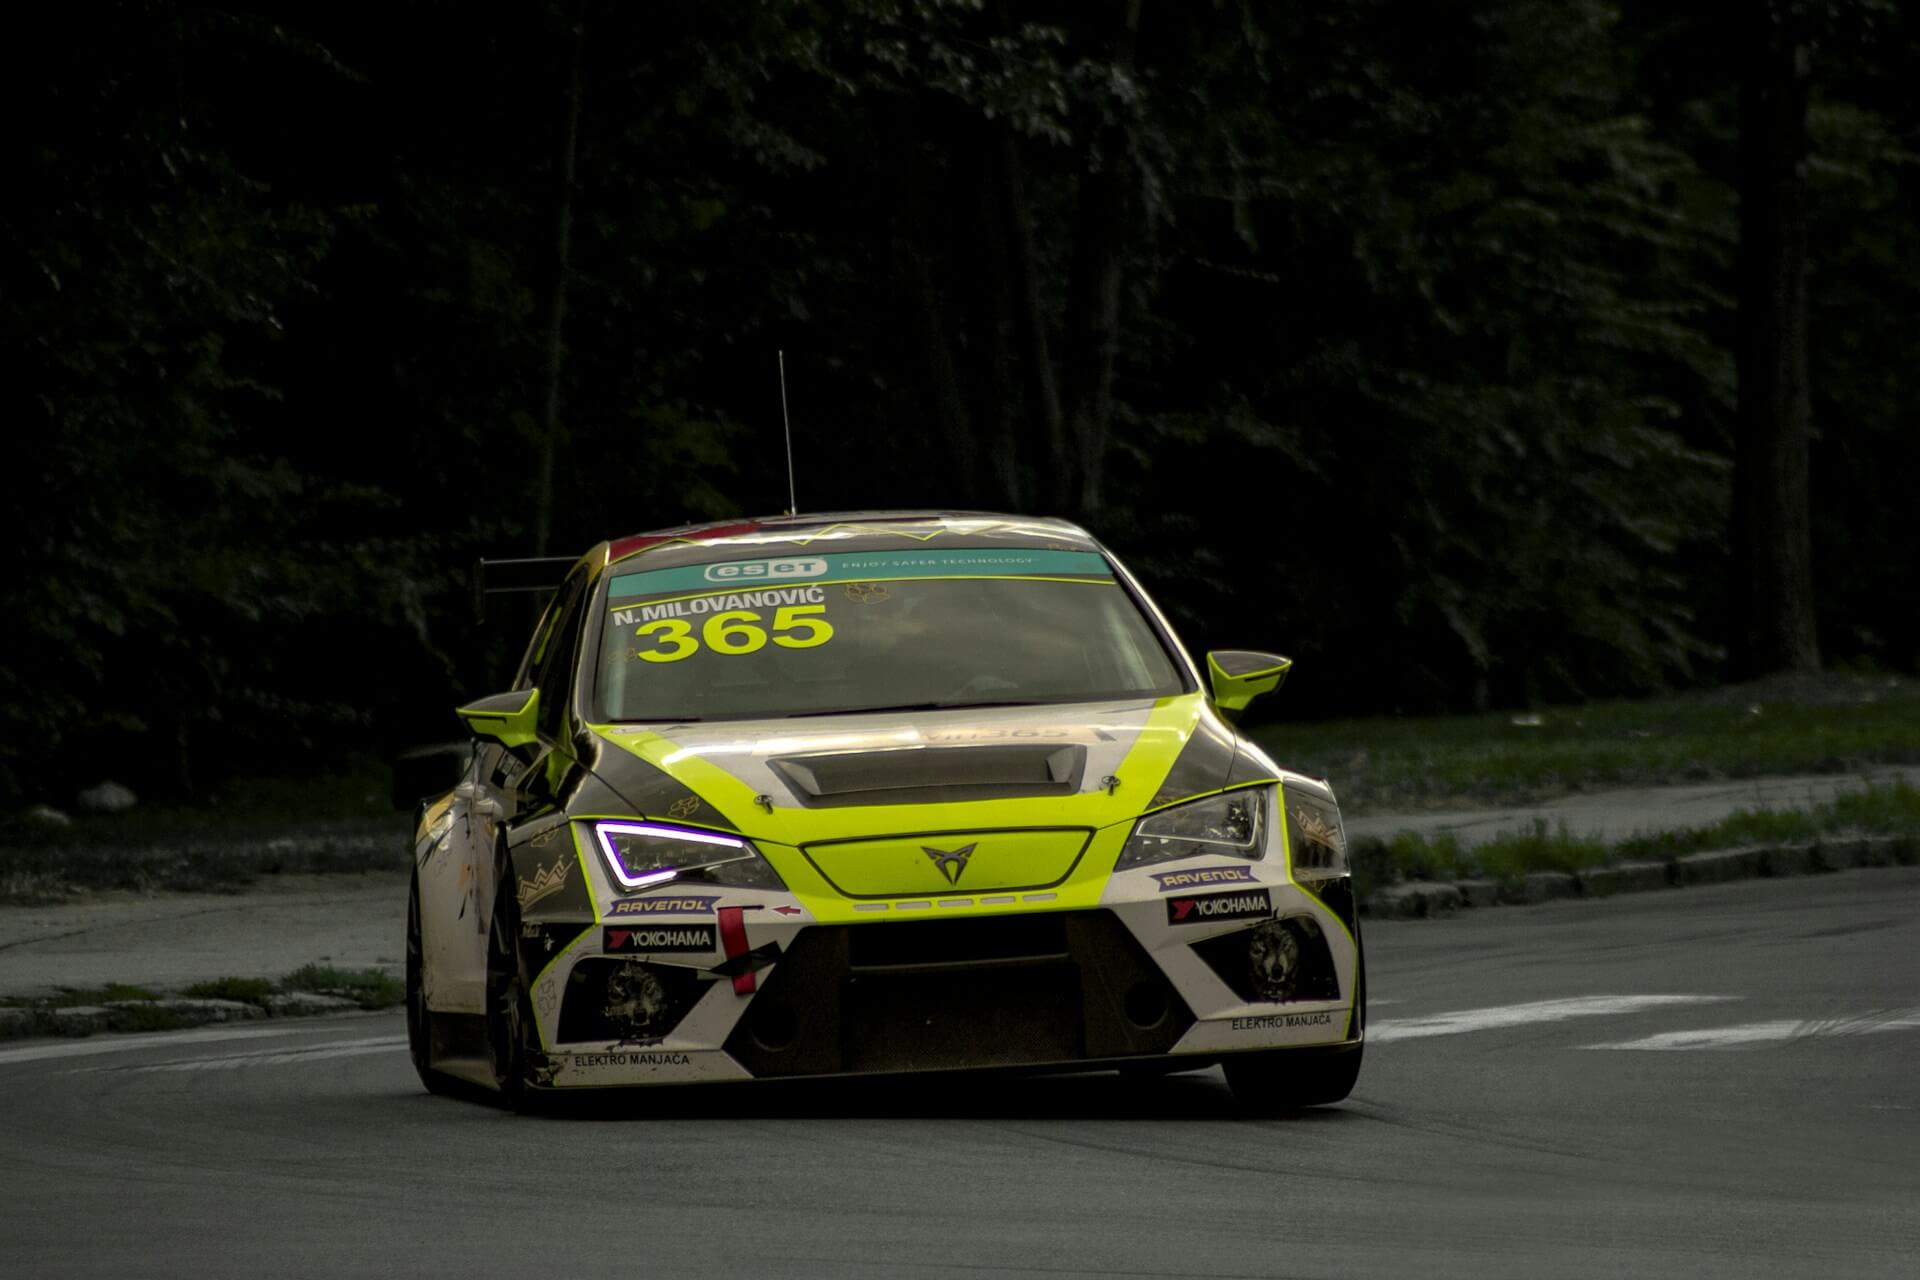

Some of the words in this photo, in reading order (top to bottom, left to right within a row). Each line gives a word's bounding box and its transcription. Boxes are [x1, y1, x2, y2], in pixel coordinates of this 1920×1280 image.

[842, 561, 888, 570] ENJOY
[892, 559, 938, 567] SAFER
[943, 557, 1033, 566] TECHNOLOGY
[635, 604, 835, 663] 365
[1163, 869, 1250, 887] RAVENOL
[616, 901, 707, 913] RAVENOL
[1196, 896, 1268, 916] YOKOHAMA
[631, 930, 711, 947] YOKOHAMA
[1232, 1017, 1284, 1031] ELEKTRO
[575, 1054, 627, 1067] ELEKTRO
